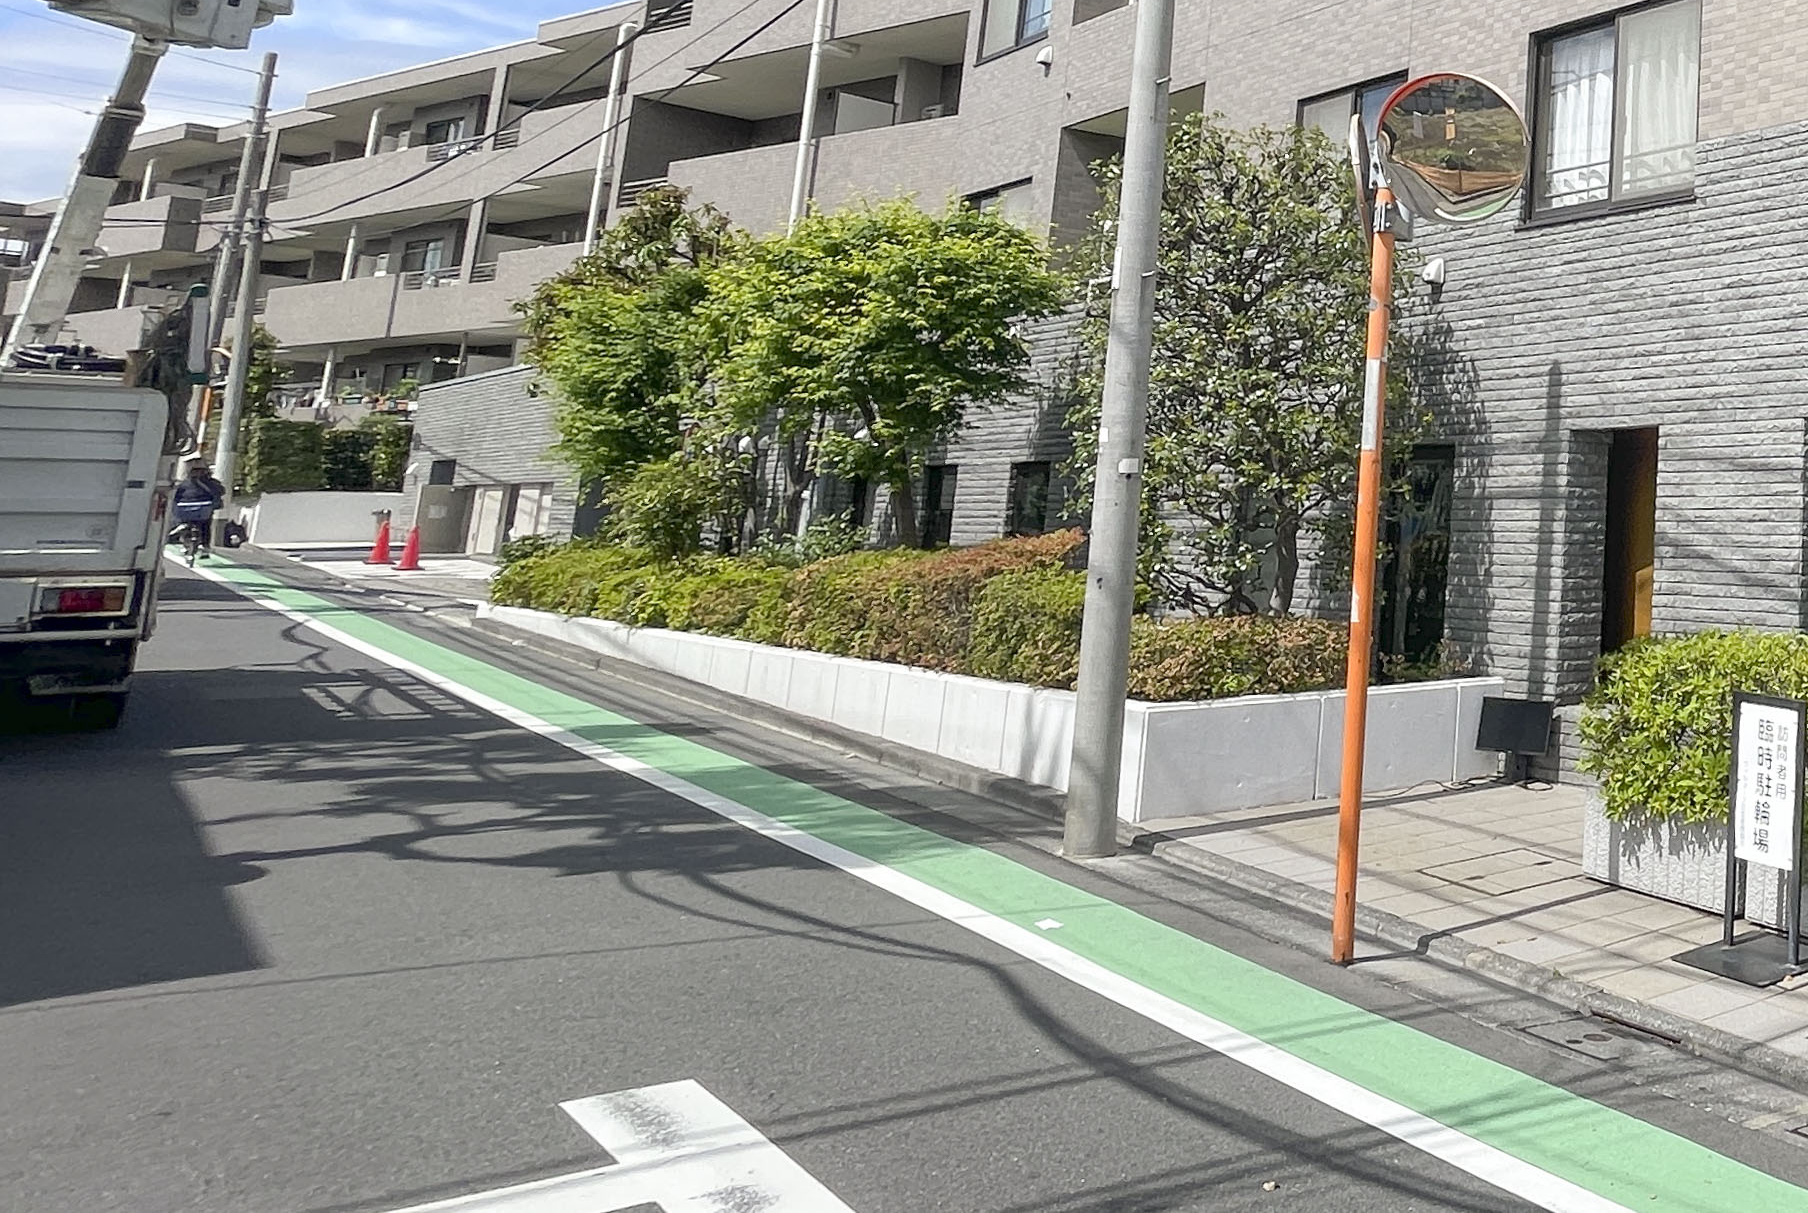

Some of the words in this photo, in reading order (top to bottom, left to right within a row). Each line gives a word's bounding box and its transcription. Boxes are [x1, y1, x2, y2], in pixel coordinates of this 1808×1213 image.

[1752, 718, 1775, 854] 臨時駐輪場
